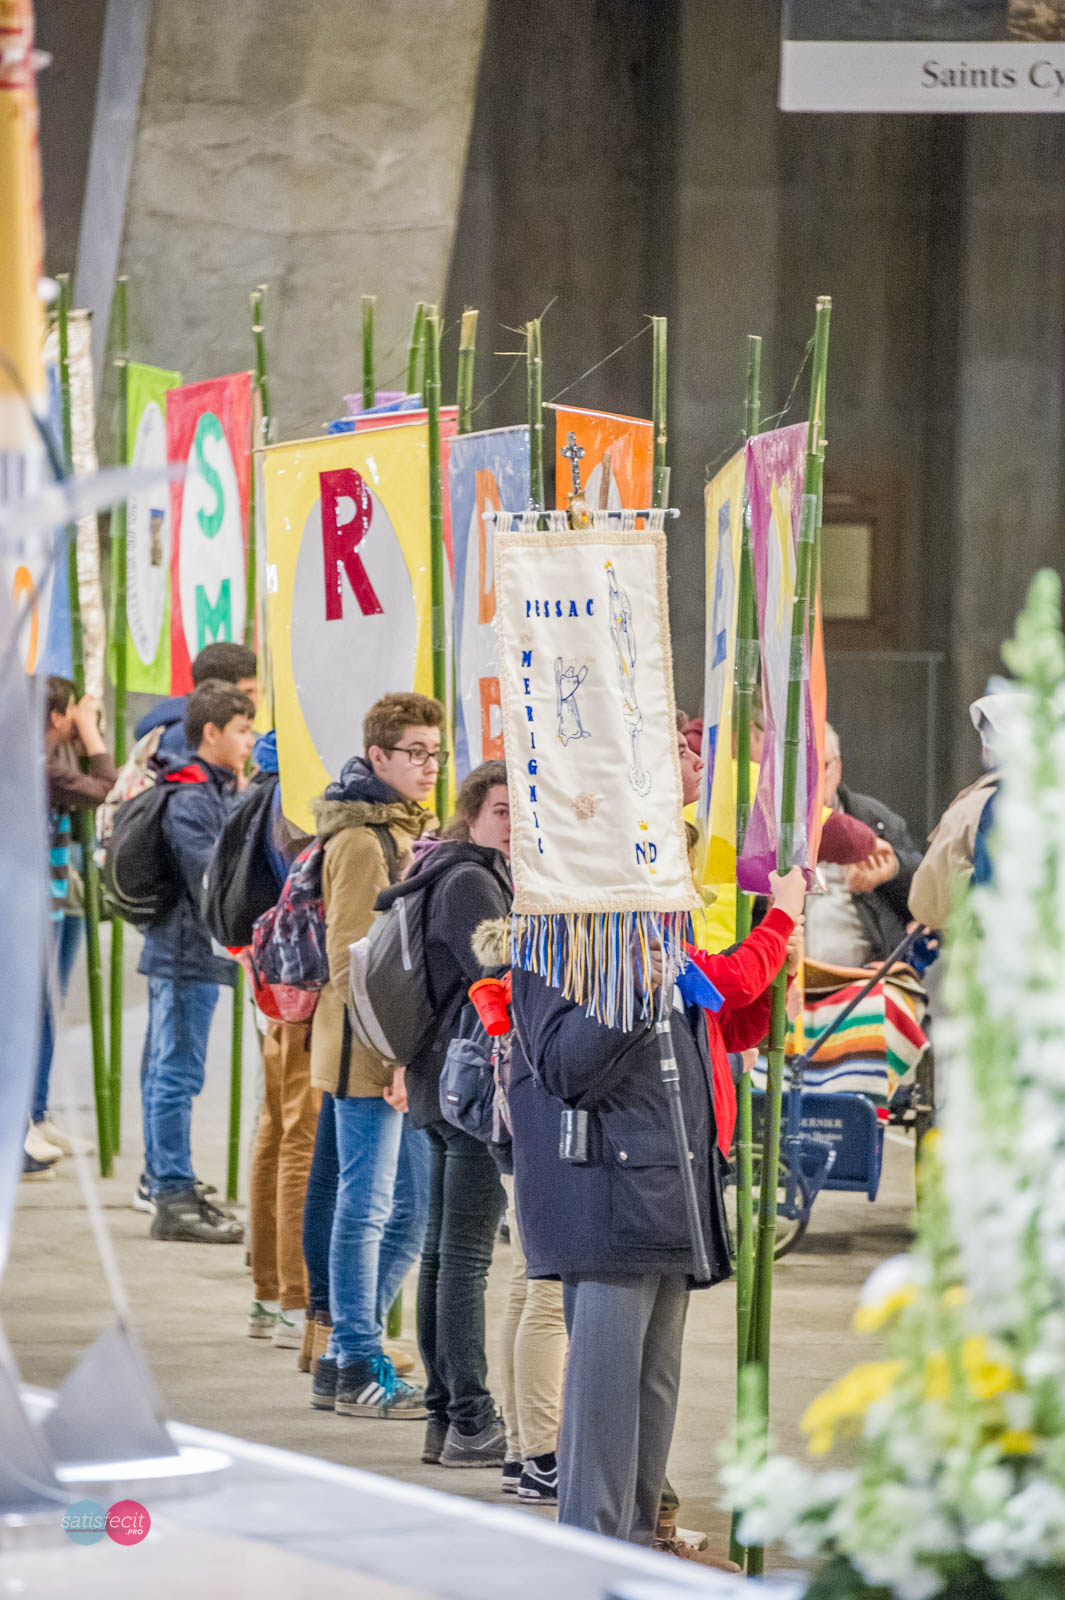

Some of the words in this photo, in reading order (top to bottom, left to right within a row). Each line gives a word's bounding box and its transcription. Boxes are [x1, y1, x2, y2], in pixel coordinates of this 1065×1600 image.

[921, 60, 1017, 89] Saints
[196, 411, 224, 539] S
[319, 467, 384, 621] R
[525, 598, 594, 618] PESSAC
[635, 841, 657, 865] ND
